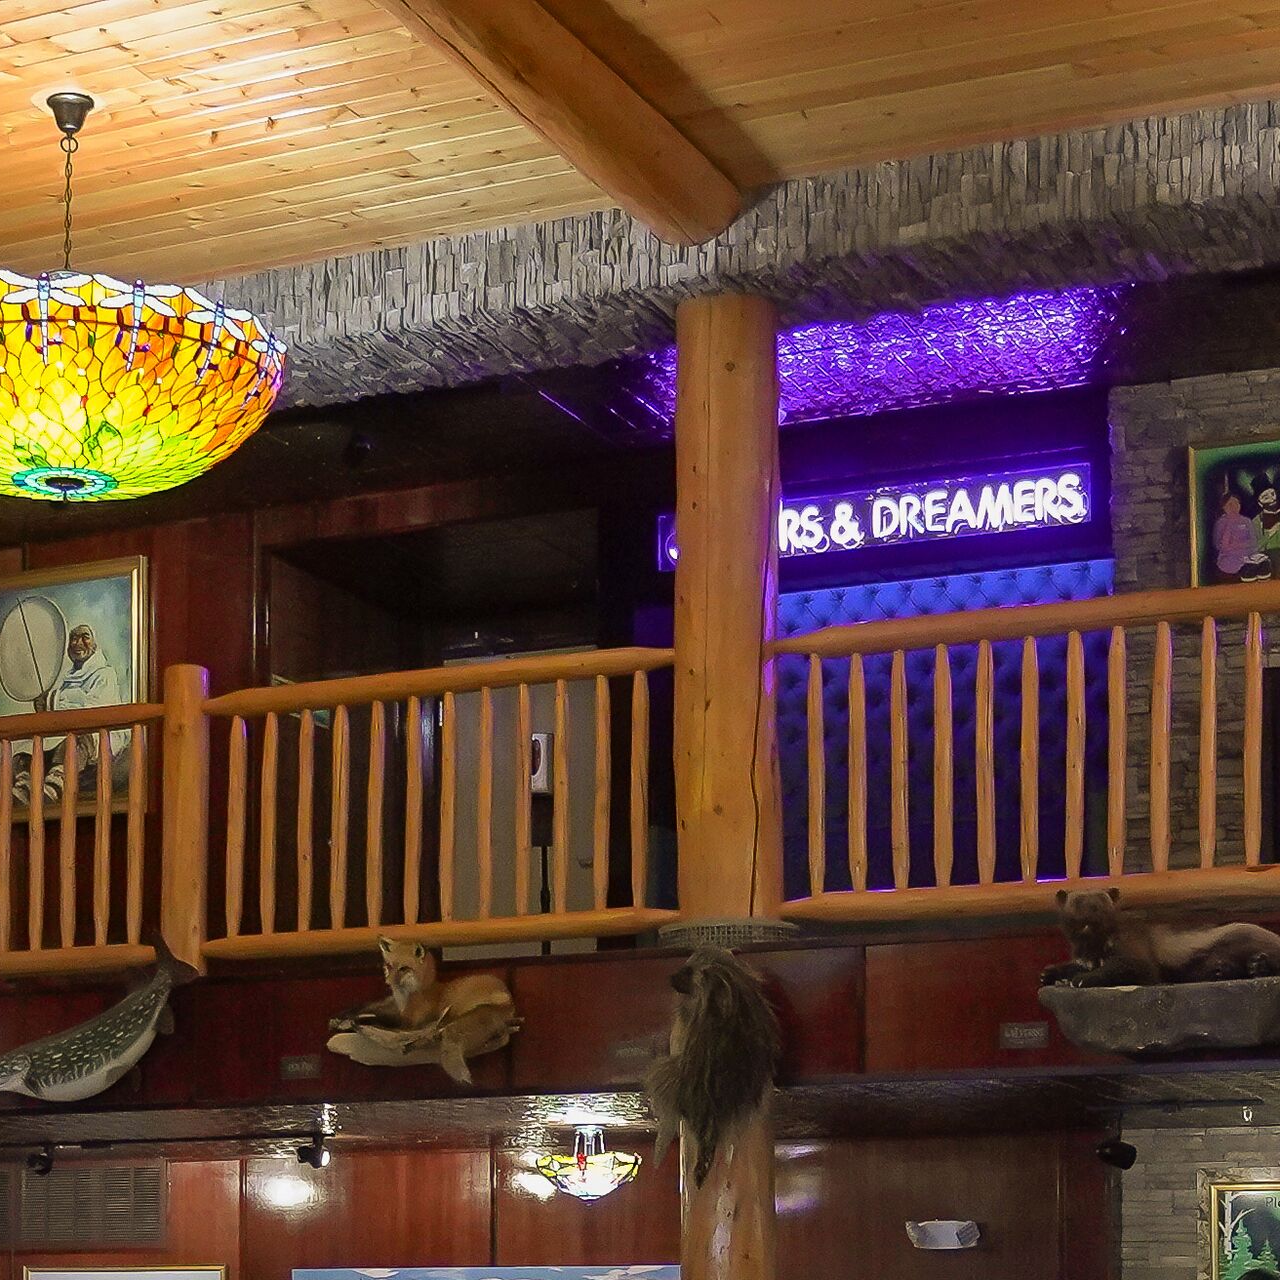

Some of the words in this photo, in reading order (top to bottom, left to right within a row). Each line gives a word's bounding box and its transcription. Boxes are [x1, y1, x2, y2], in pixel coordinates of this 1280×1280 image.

[778, 503, 824, 553] RS
[830, 502, 865, 545] &
[871, 474, 1082, 540] DREAMERS
